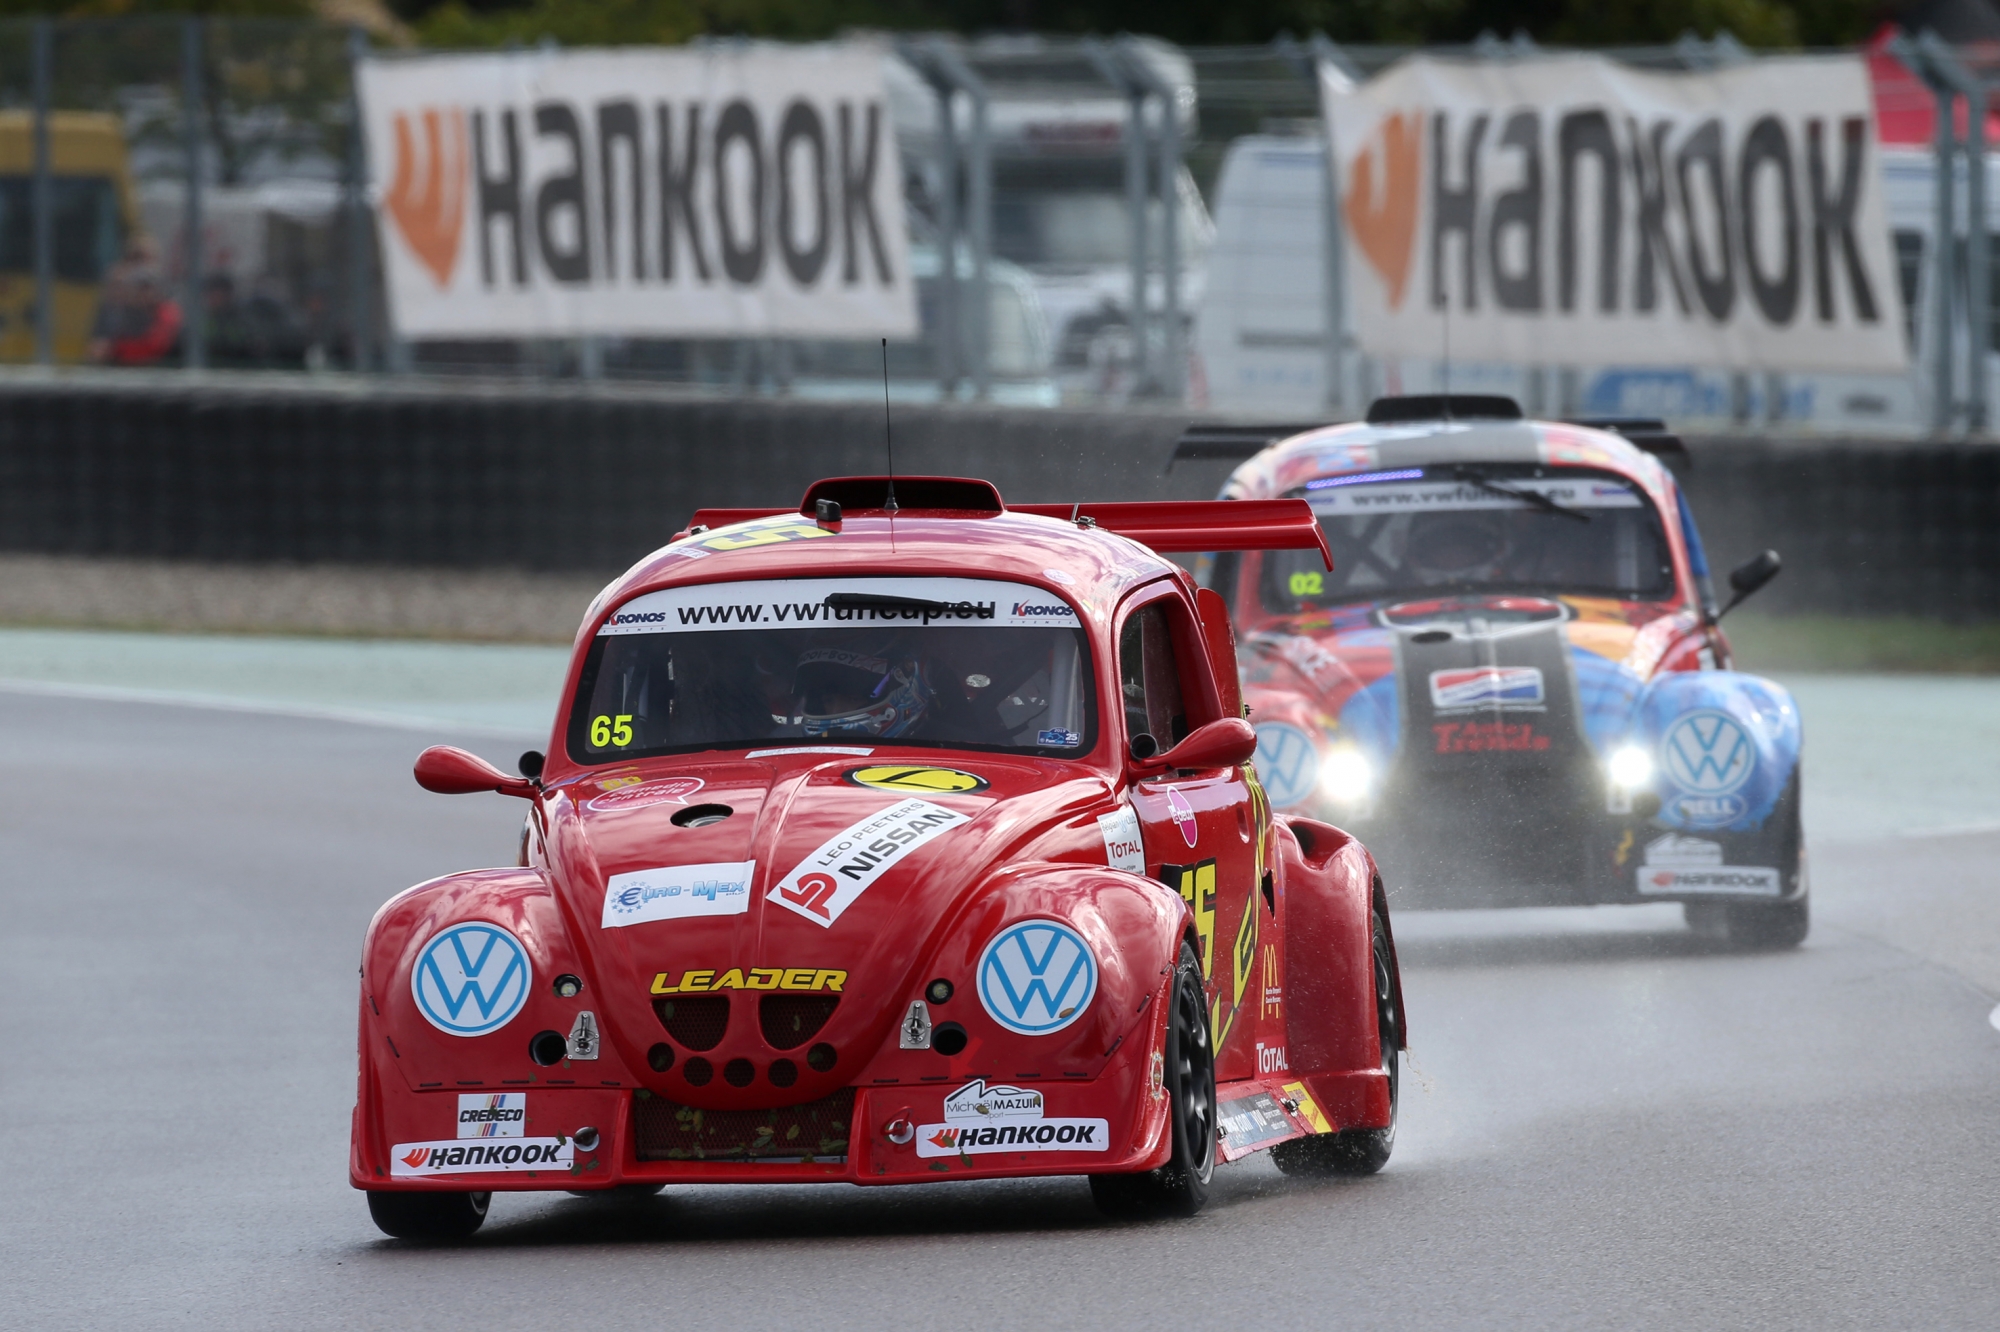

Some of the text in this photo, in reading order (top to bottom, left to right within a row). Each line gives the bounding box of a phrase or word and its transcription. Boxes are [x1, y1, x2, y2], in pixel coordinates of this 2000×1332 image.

[1289, 572, 1324, 596] 02
[604, 608, 667, 626] KRONOS
[1011, 599, 1074, 616] KRONOS
[590, 714, 633, 748] 65
[1065, 733, 1078, 741] 25
[817, 802, 925, 866] LEO PEETERS
[838, 809, 957, 881] NISSAN
[650, 967, 849, 995] LEADER
[459, 1109, 523, 1123] CREDECO
